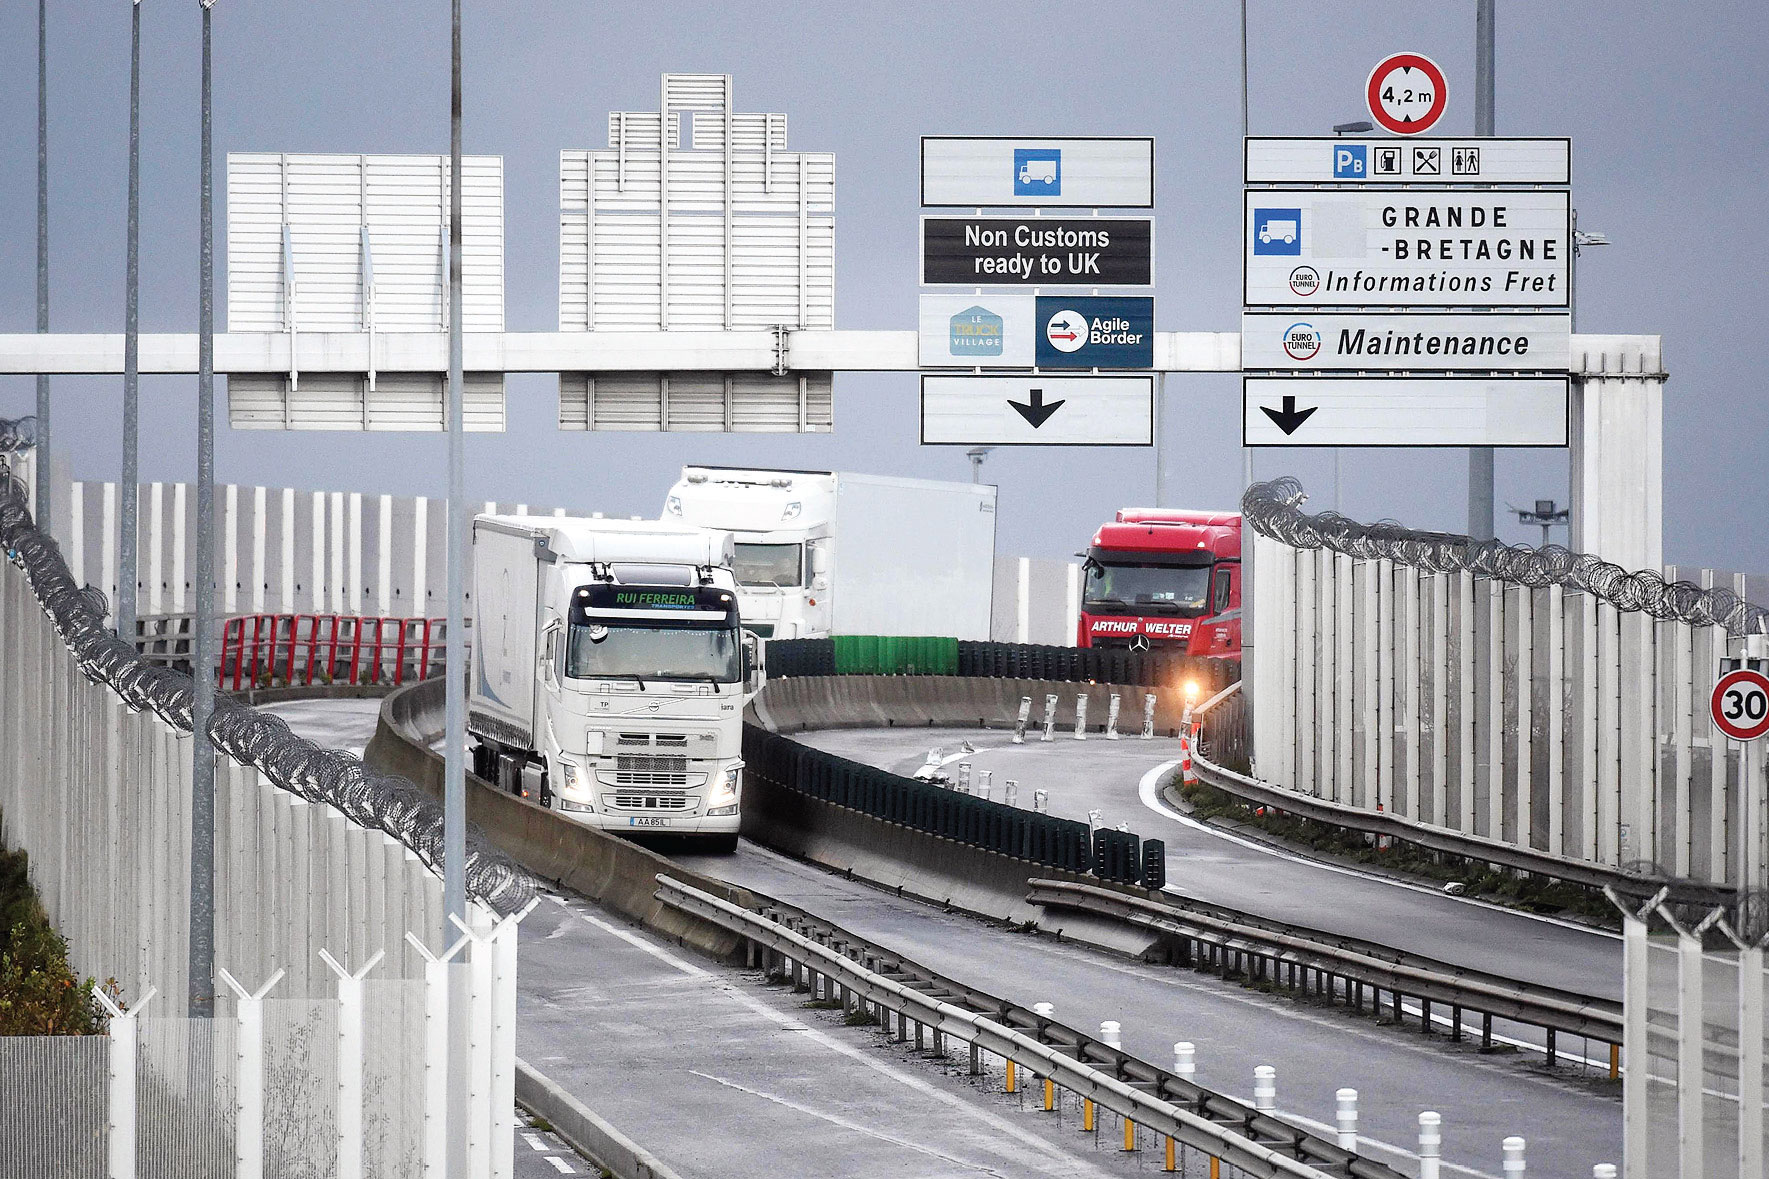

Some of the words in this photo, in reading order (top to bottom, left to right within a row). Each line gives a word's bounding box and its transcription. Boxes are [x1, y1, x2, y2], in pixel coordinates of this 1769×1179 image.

[1382, 86, 1414, 106] 4,2
[1418, 92, 1432, 103] m
[1382, 206, 1507, 227] GRANDE
[965, 225, 1008, 247] Non
[1014, 225, 1110, 248] Customs
[975, 253, 1034, 279] ready
[1040, 256, 1061, 274] to
[1068, 253, 1100, 274] UK
[1325, 270, 1492, 292] Informations
[1505, 270, 1557, 292] Fret
[971, 315, 982, 323] LE
[1090, 317, 1130, 334] Agile
[954, 325, 999, 336] TRUCK
[1291, 333, 1313, 341] EURO
[953, 338, 1000, 346] VILLAGE
[1090, 332, 1143, 345] Border
[1287, 341, 1316, 350] TUNNEL
[1337, 329, 1529, 355] Maintenance
[616, 592, 637, 604] RUI
[639, 593, 696, 605] FERREIRA
[1091, 621, 1138, 633] ARTHUR
[1145, 622, 1192, 634] WELTER
[1724, 690, 1767, 720] 30
